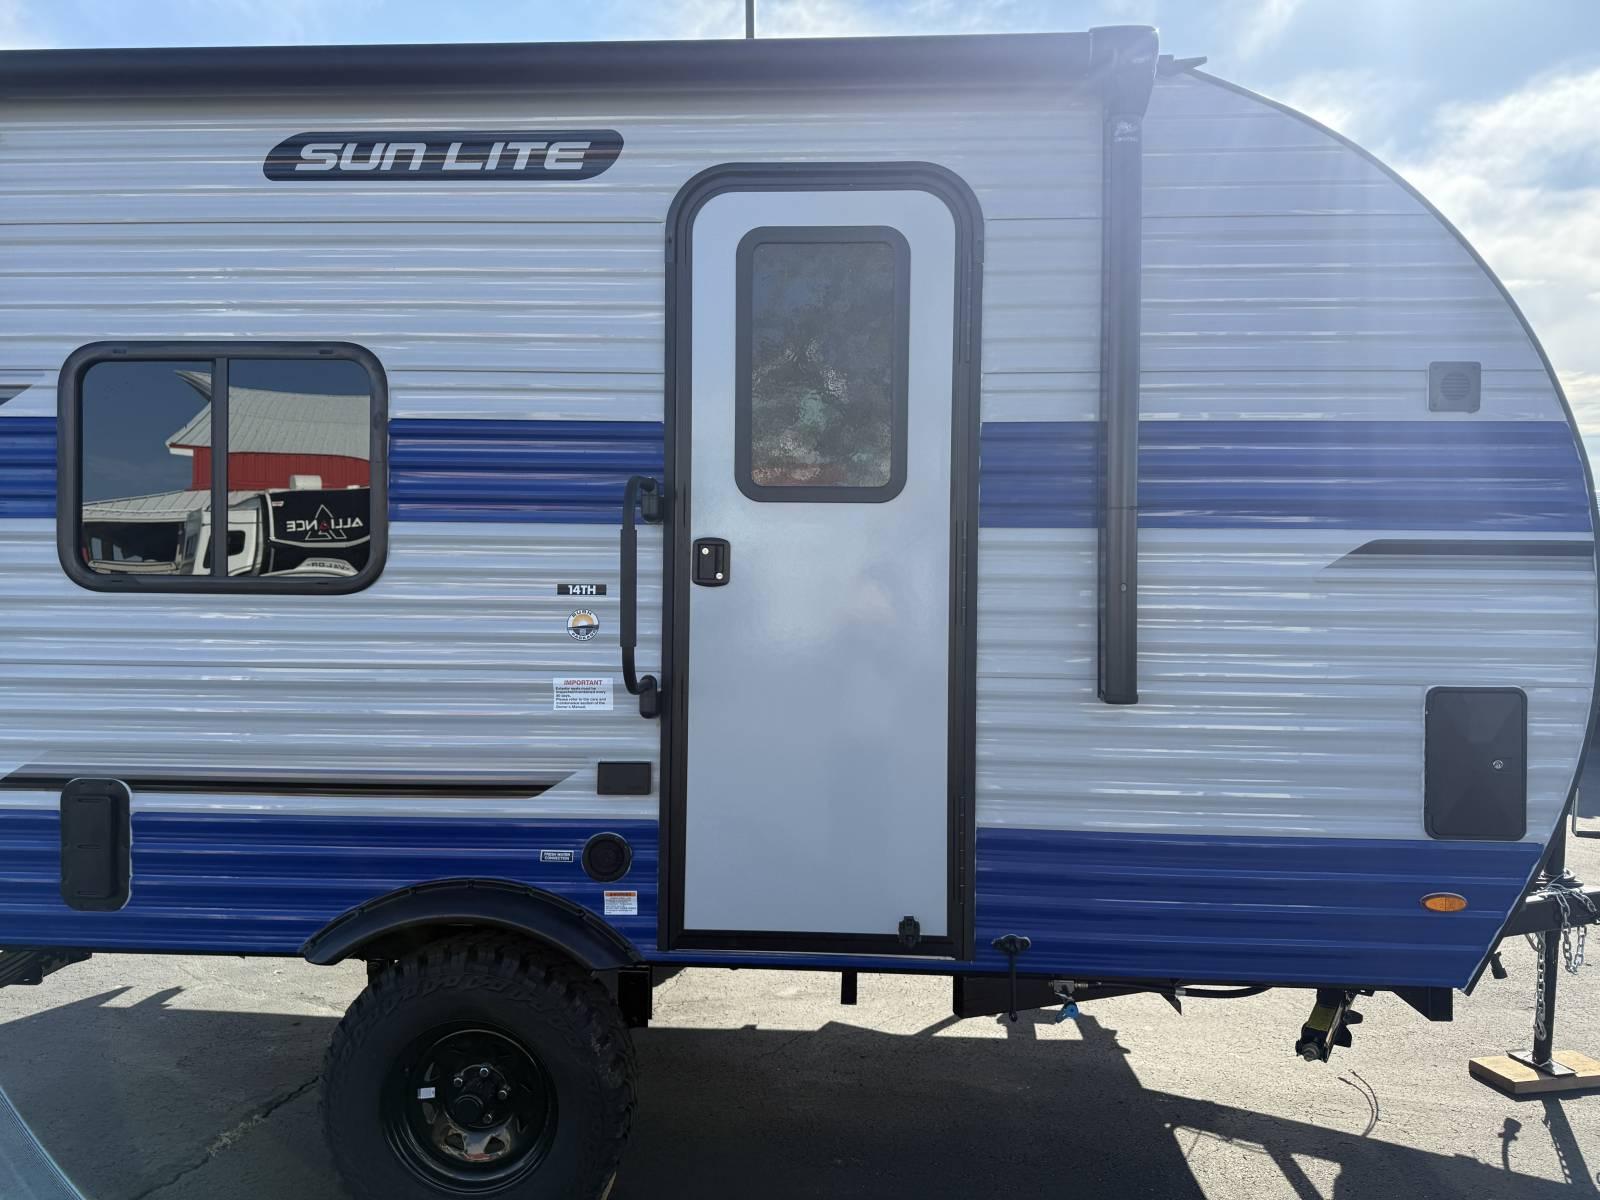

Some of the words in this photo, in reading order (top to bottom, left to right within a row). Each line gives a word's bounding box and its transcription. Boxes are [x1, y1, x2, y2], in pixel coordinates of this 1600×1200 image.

[294, 142, 427, 171] SUN
[442, 141, 591, 170] LITE
[568, 584, 596, 595] 14TH
